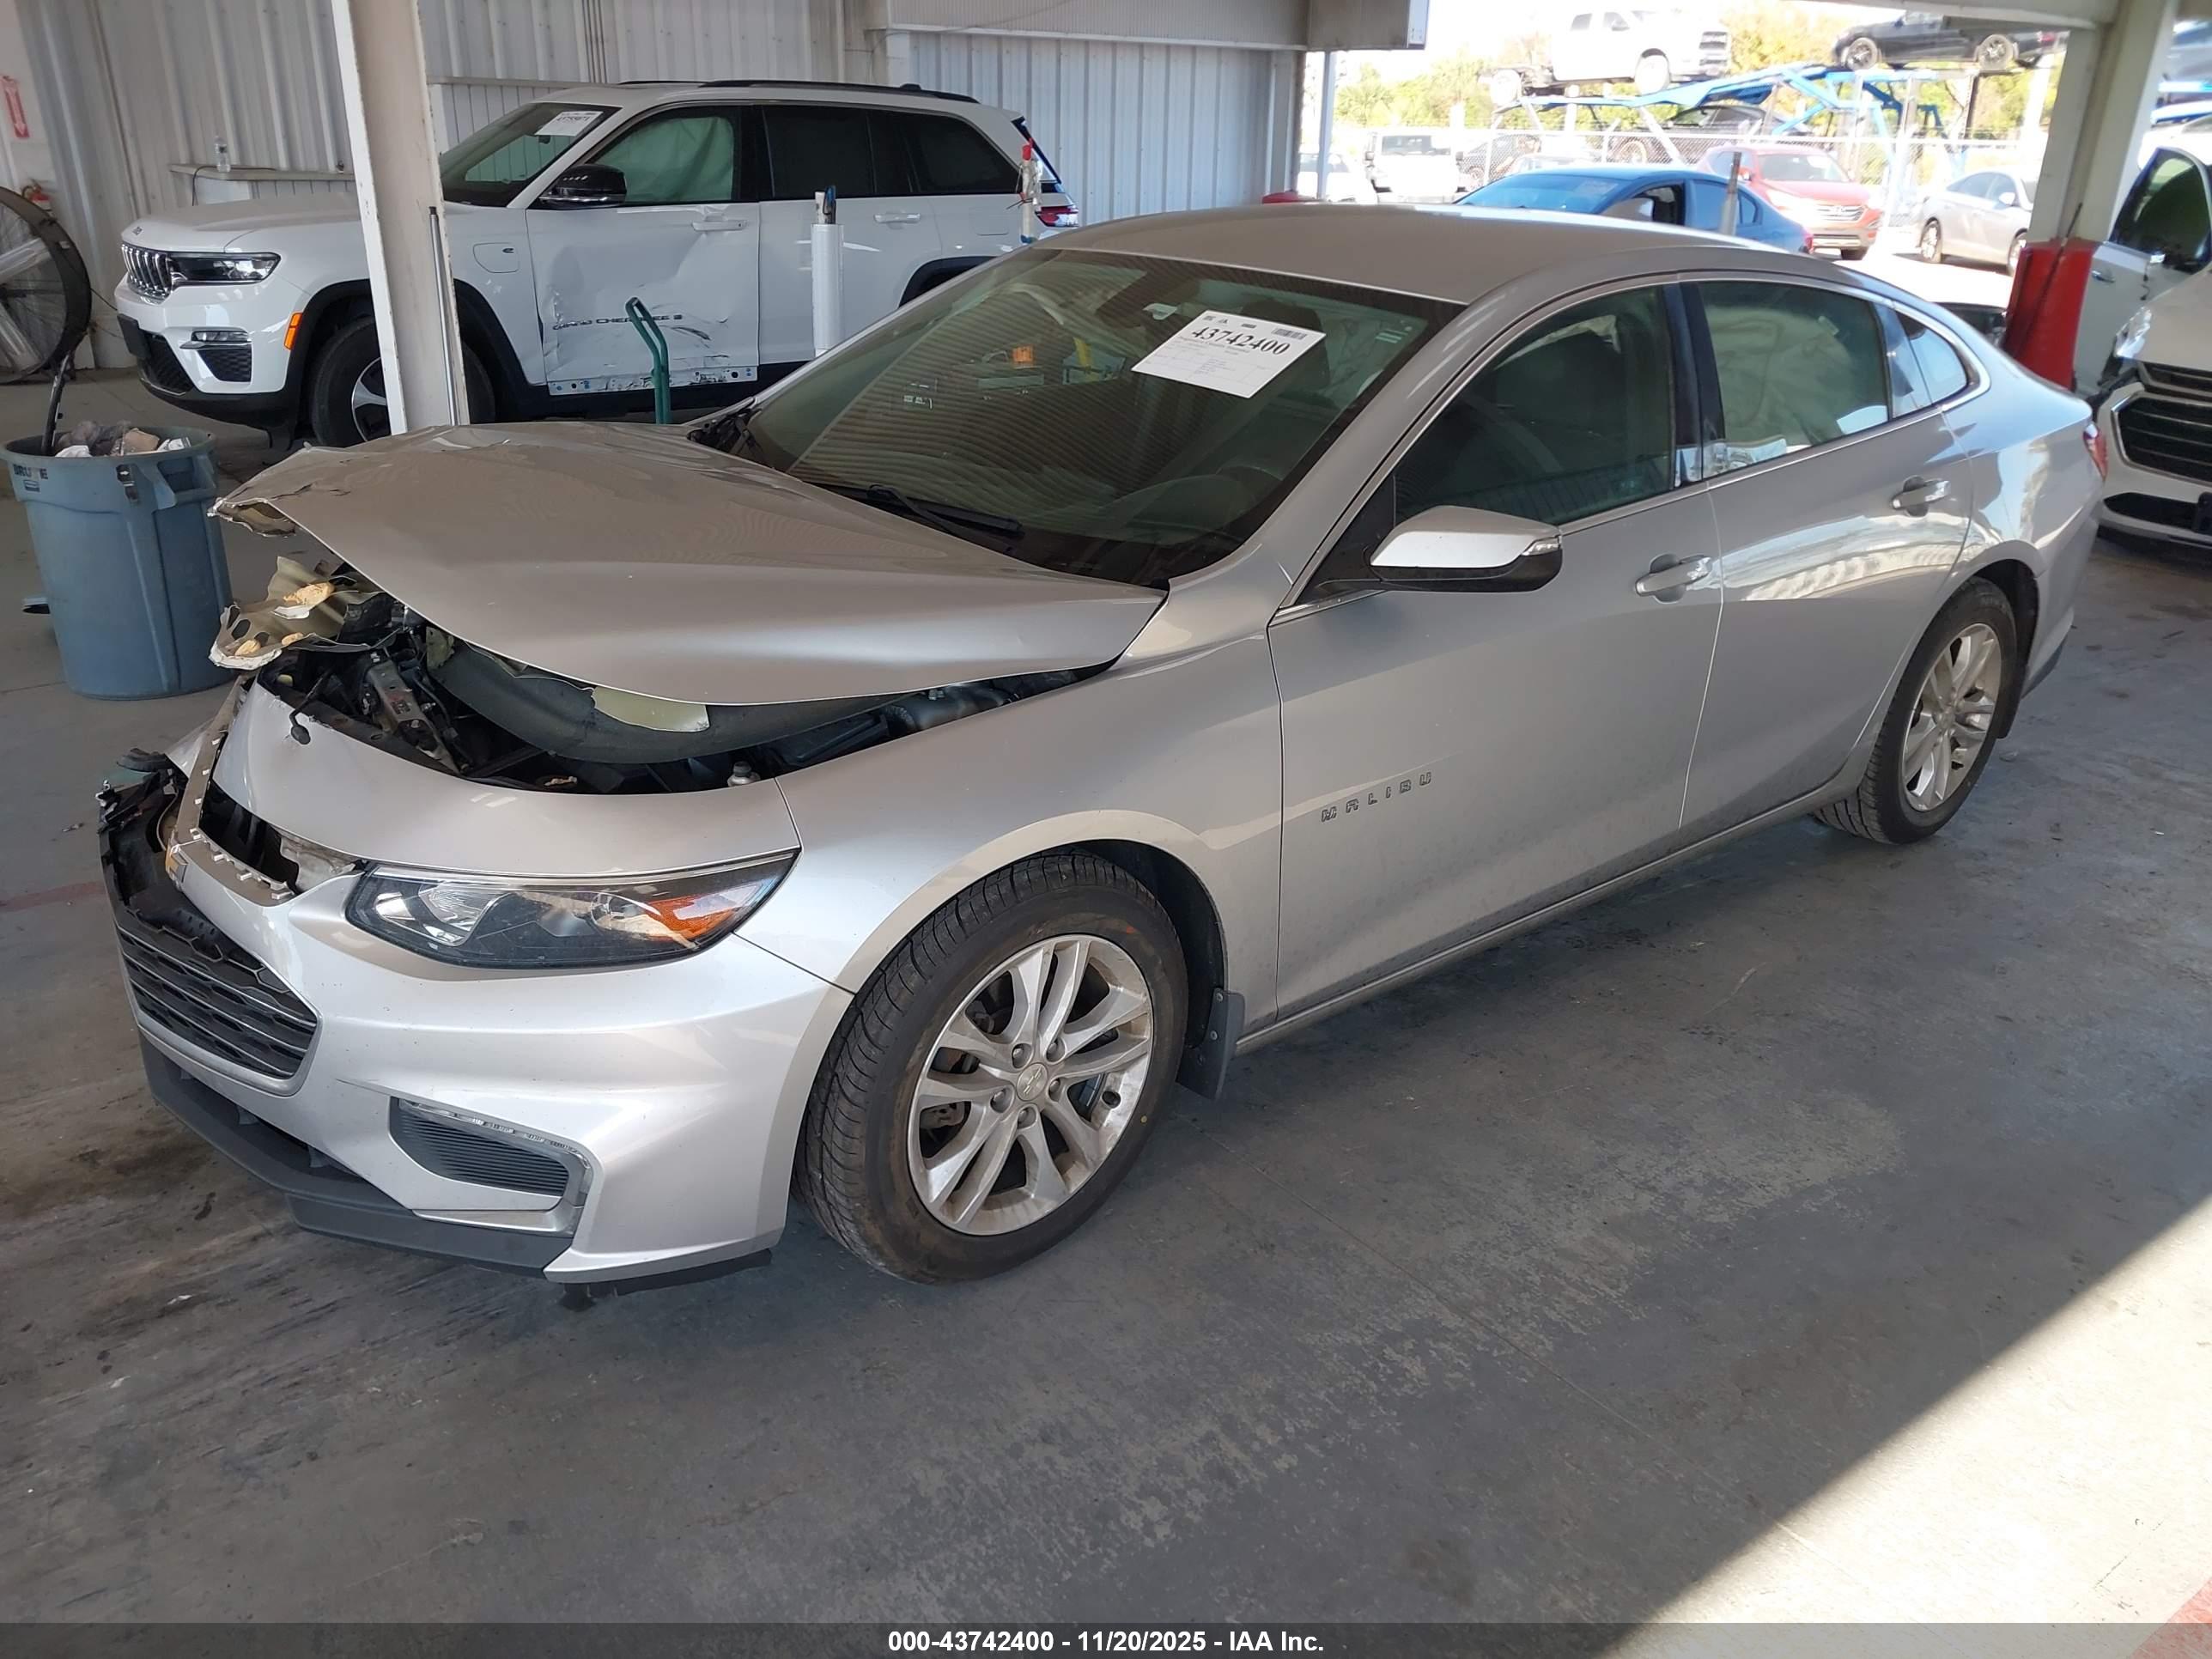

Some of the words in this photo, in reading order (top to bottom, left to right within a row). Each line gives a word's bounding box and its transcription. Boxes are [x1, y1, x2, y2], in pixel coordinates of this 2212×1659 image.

[596, 314, 671, 325] CHEREE
[1192, 326, 1291, 356] 43742400
[13, 463, 49, 480] BRUE
[1321, 771, 1432, 823] MALIBU
